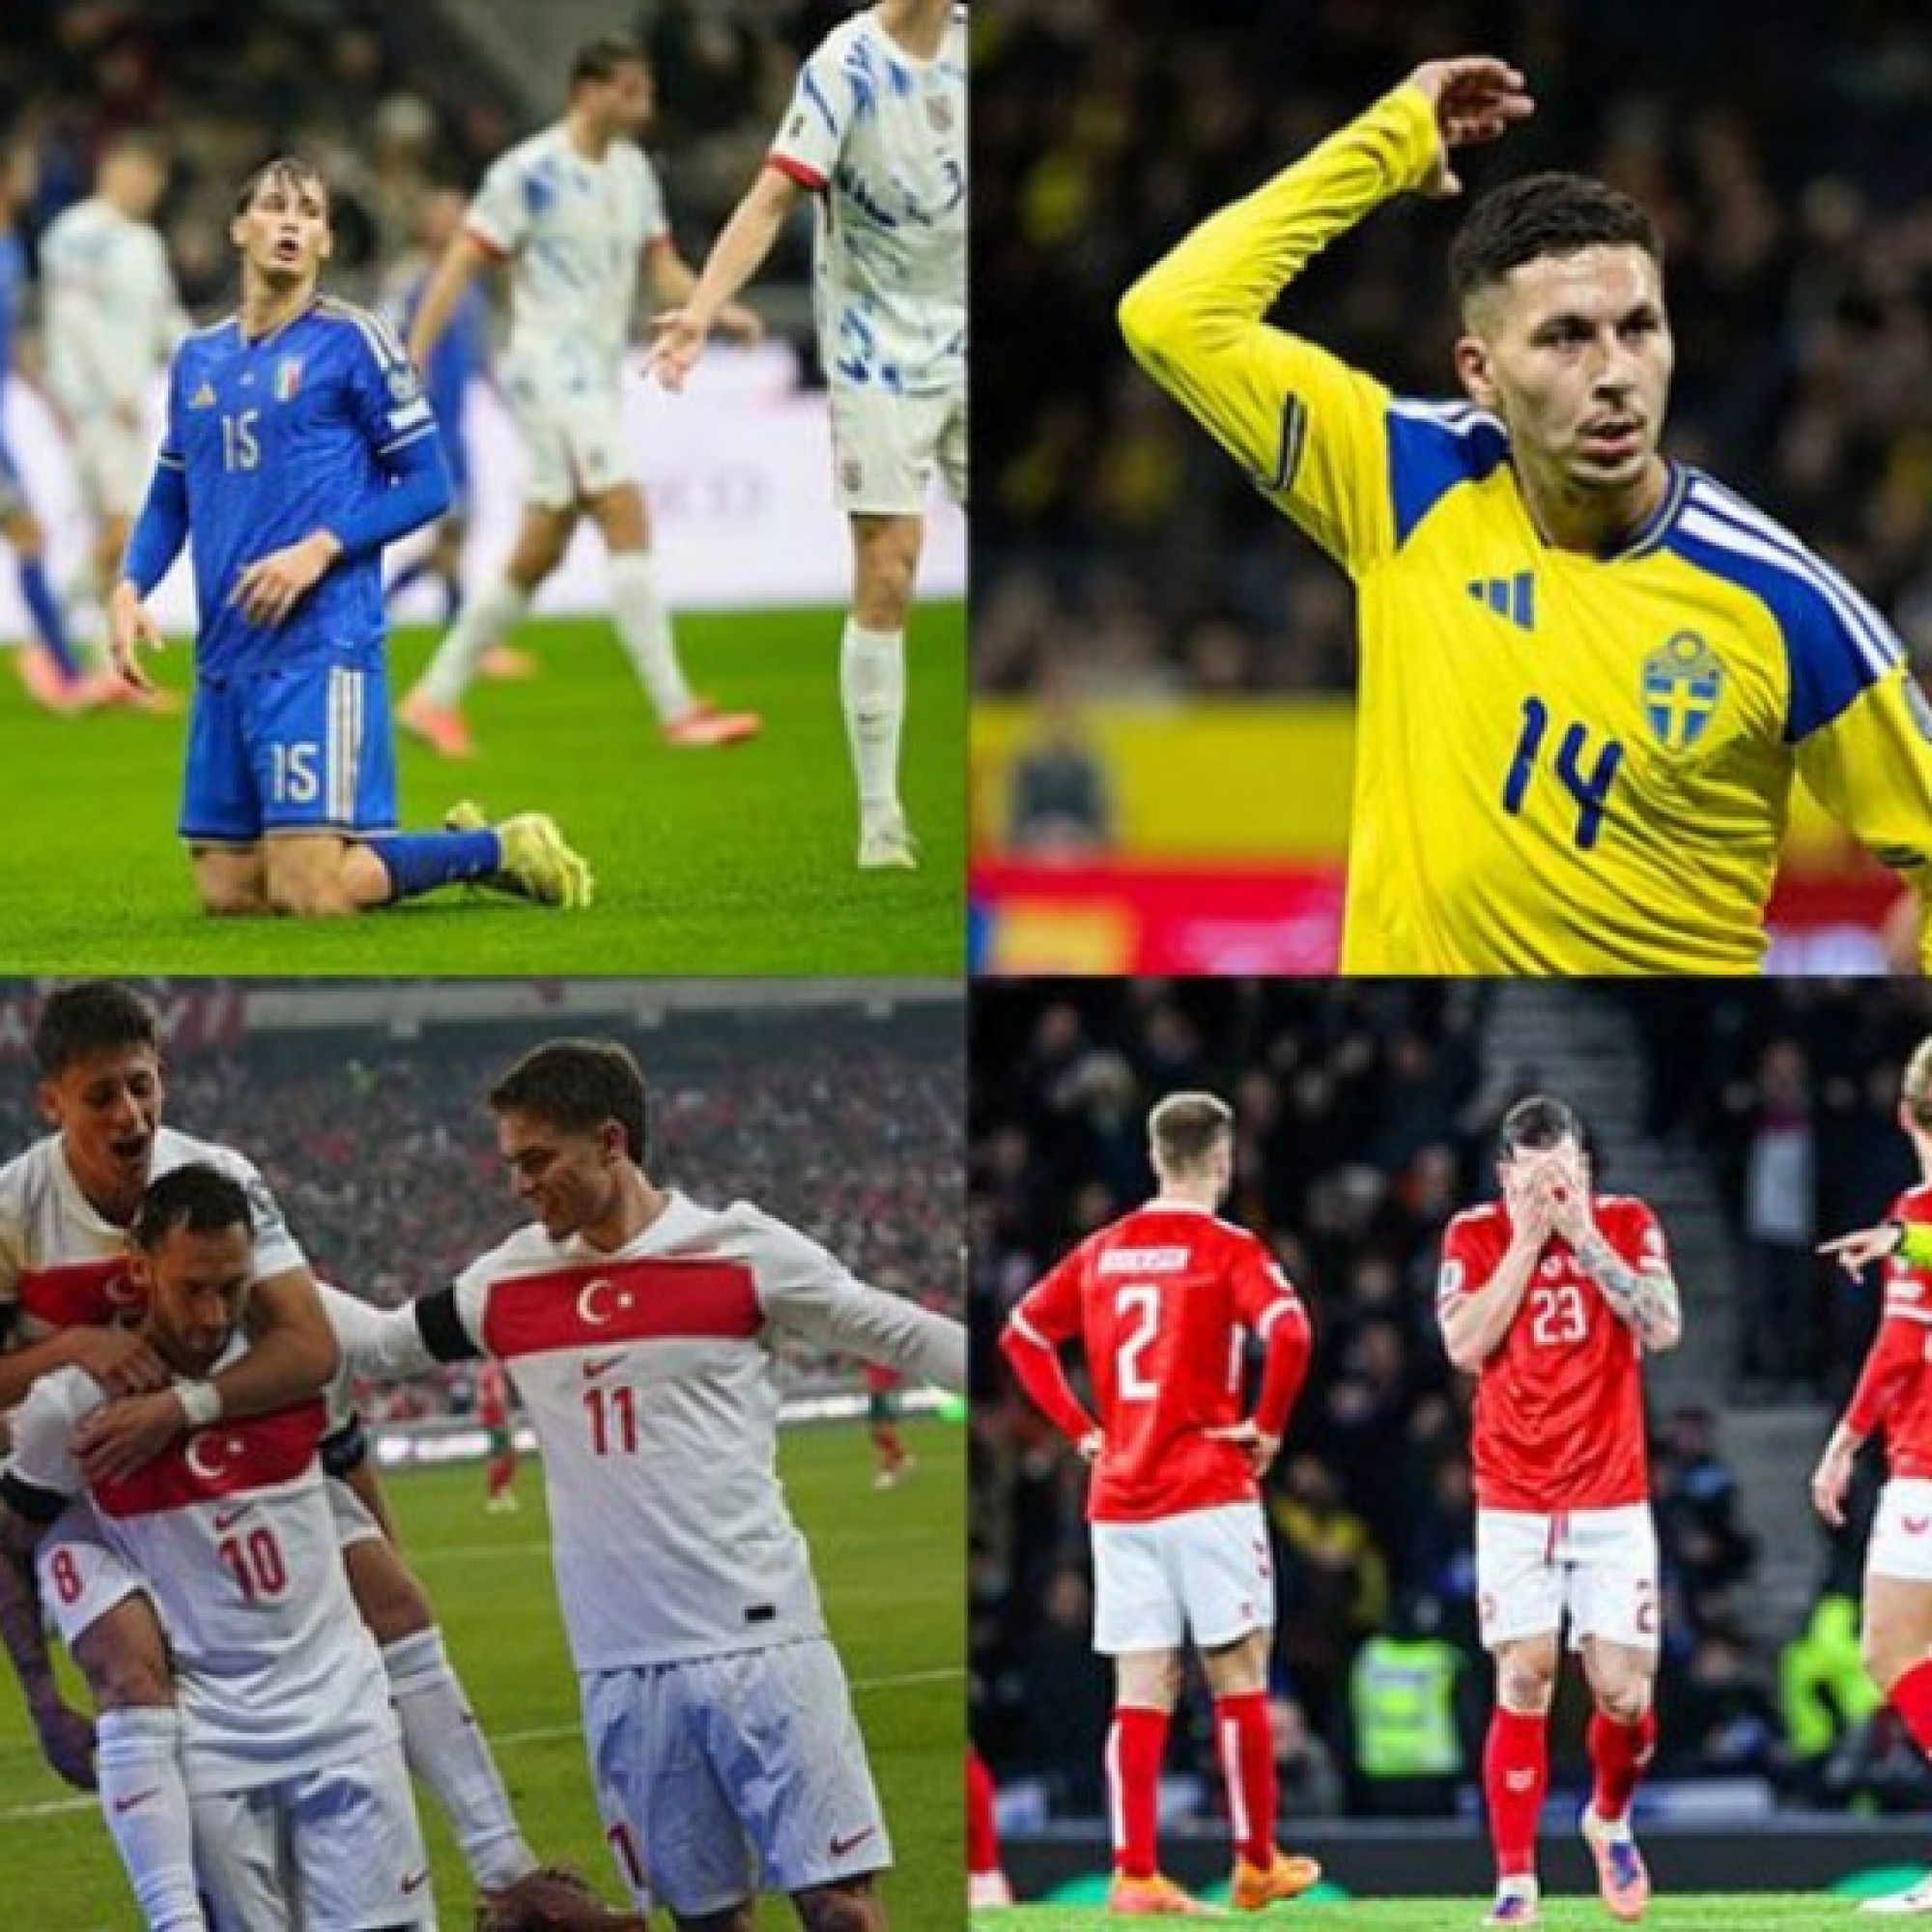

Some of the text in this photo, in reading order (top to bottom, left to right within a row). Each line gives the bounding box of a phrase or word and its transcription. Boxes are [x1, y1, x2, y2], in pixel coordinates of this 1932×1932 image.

[221, 409, 261, 473] 15
[272, 742, 319, 803] 15
[1501, 696, 1624, 850] 14
[1114, 1285, 1159, 1401] 2
[1530, 1286, 1587, 1344] 23
[582, 1386, 638, 1456] 11
[51, 1549, 83, 1606] 8
[218, 1527, 286, 1609] 10
